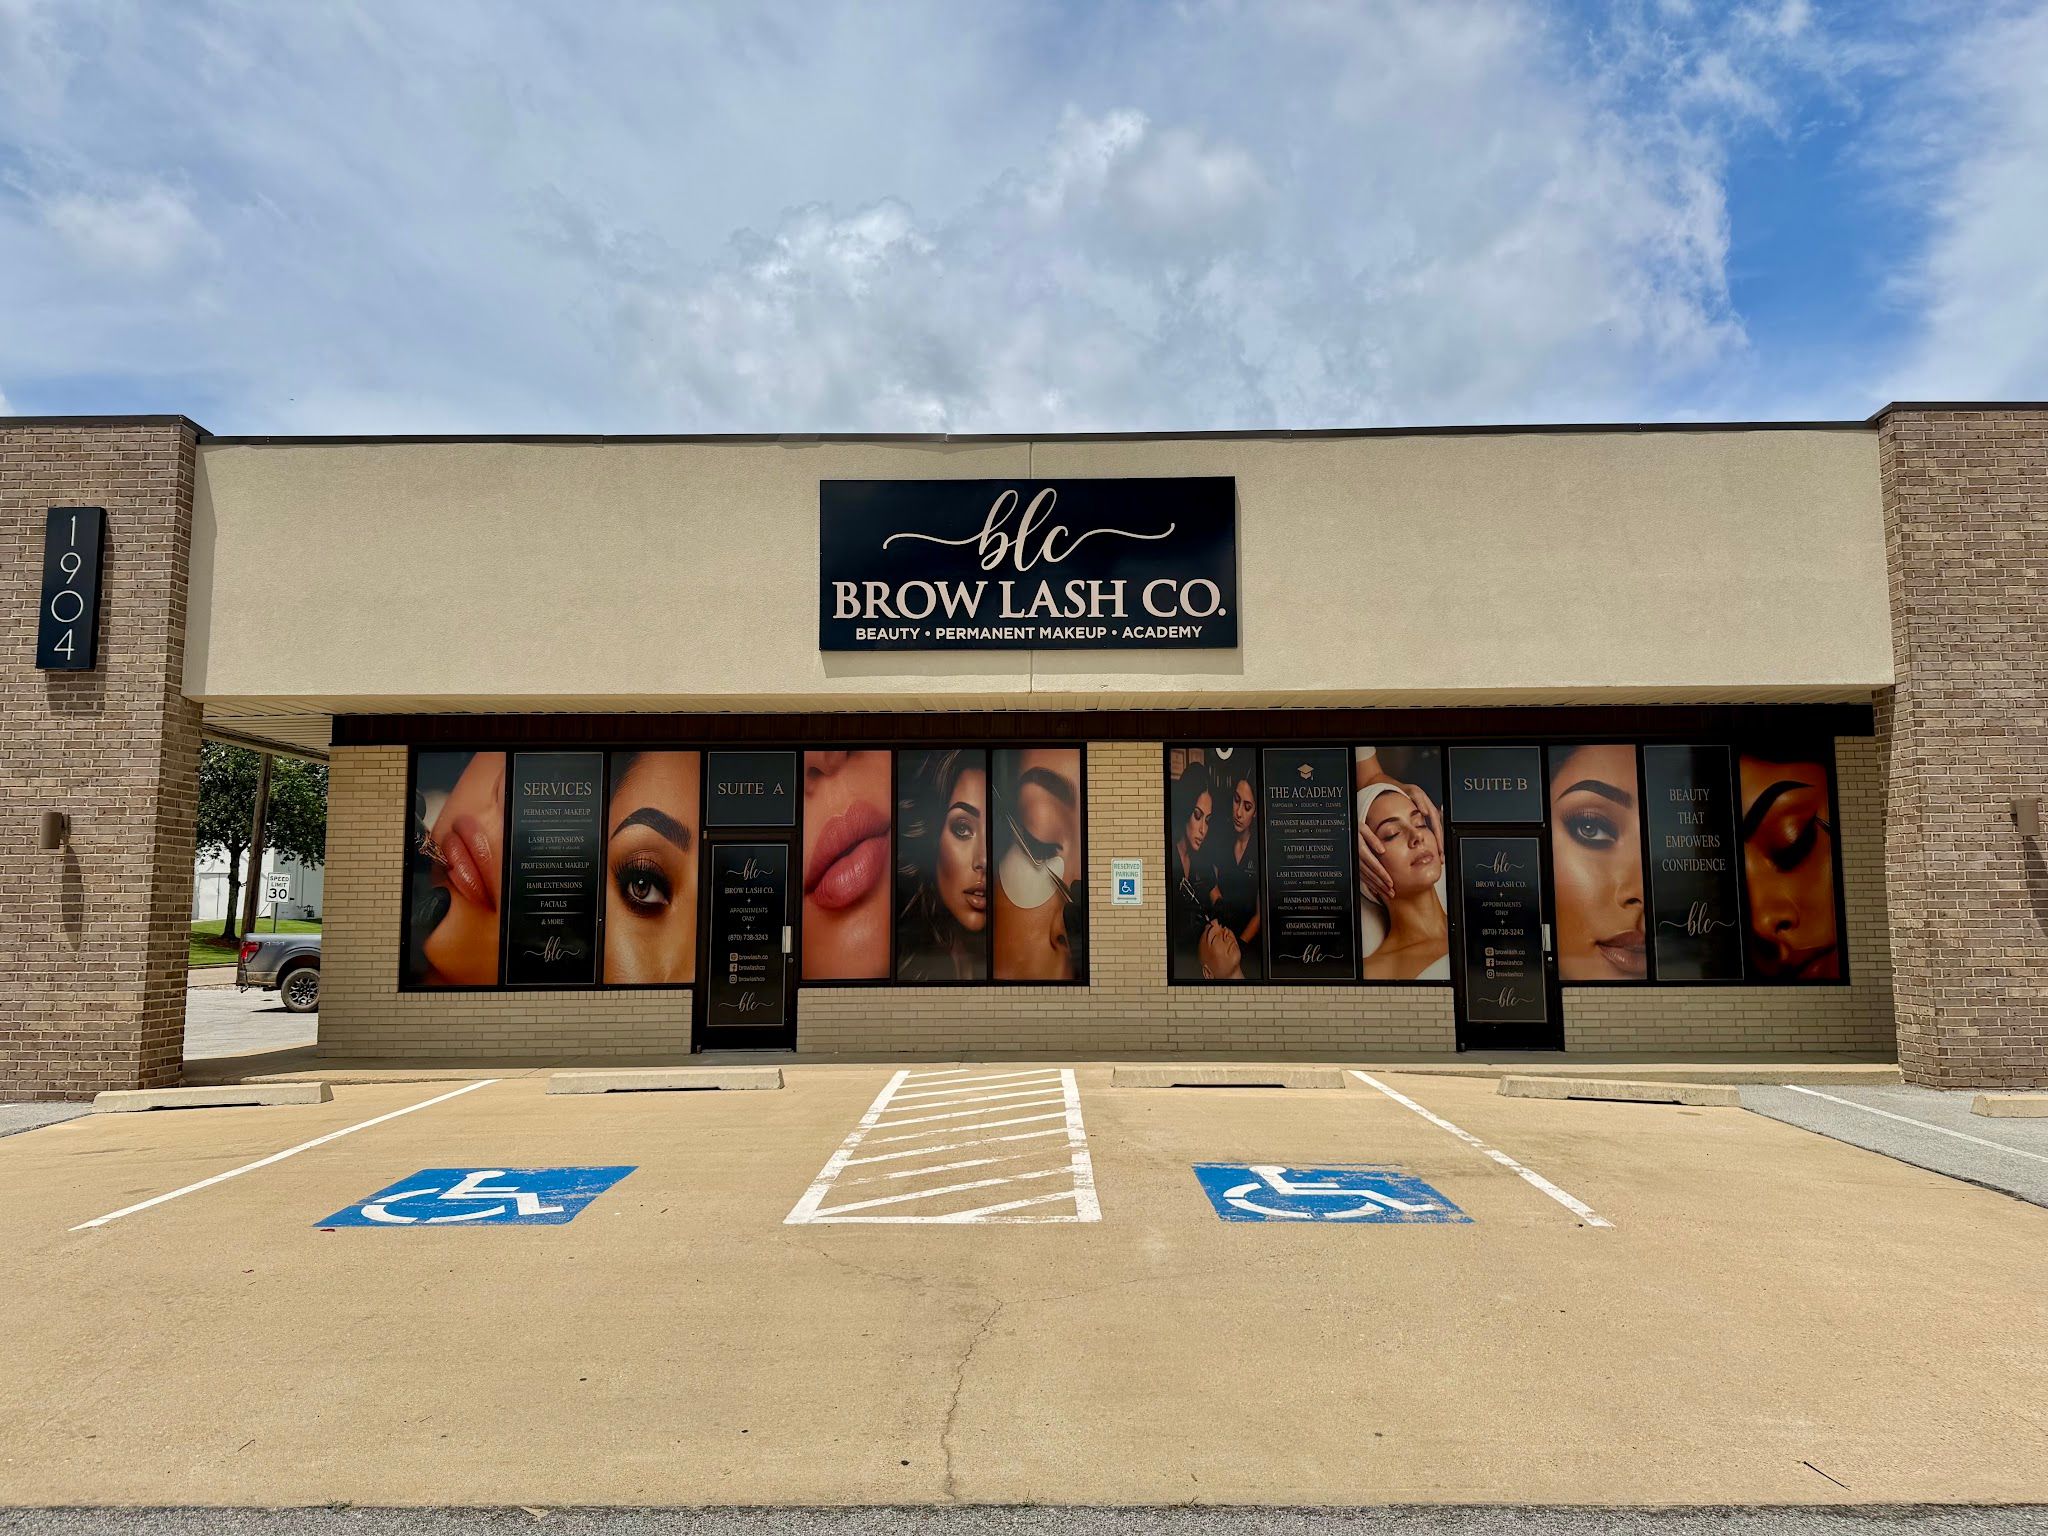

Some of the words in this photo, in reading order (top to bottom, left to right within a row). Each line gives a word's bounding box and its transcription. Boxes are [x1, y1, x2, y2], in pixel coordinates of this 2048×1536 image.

[883, 488, 1175, 572] blc
[51, 515, 84, 661] 1904
[832, 581, 989, 619] BROW
[998, 579, 1128, 619] LASH
[1142, 578, 1227, 618] CO.
[855, 627, 920, 641] BEAUTY
[935, 627, 1036, 640] PERMANENT
[1039, 626, 1108, 640] MAKEUP
[1121, 625, 1203, 639] ACADEMY
[523, 782, 592, 796] SERVICES
[717, 782, 765, 795] SUITE
[772, 782, 785, 795] A
[1463, 778, 1513, 791] SUITE
[1517, 778, 1528, 791] B
[1268, 786, 1290, 799] THE
[1291, 786, 1344, 799] ACADEMY
[1669, 788, 1710, 801] BEAUTY
[523, 808, 561, 816] PERMANENT
[562, 808, 591, 816] MAKEUP
[1677, 811, 1705, 825] THAT
[528, 836, 545, 844] LASH
[545, 835, 585, 844] EXTENSIONS
[1665, 835, 1721, 848] EMPOWERS
[521, 862, 564, 870] PROFESSIONAL
[1662, 858, 1726, 872] CONFIDENCE
[268, 888, 288, 899] 30
